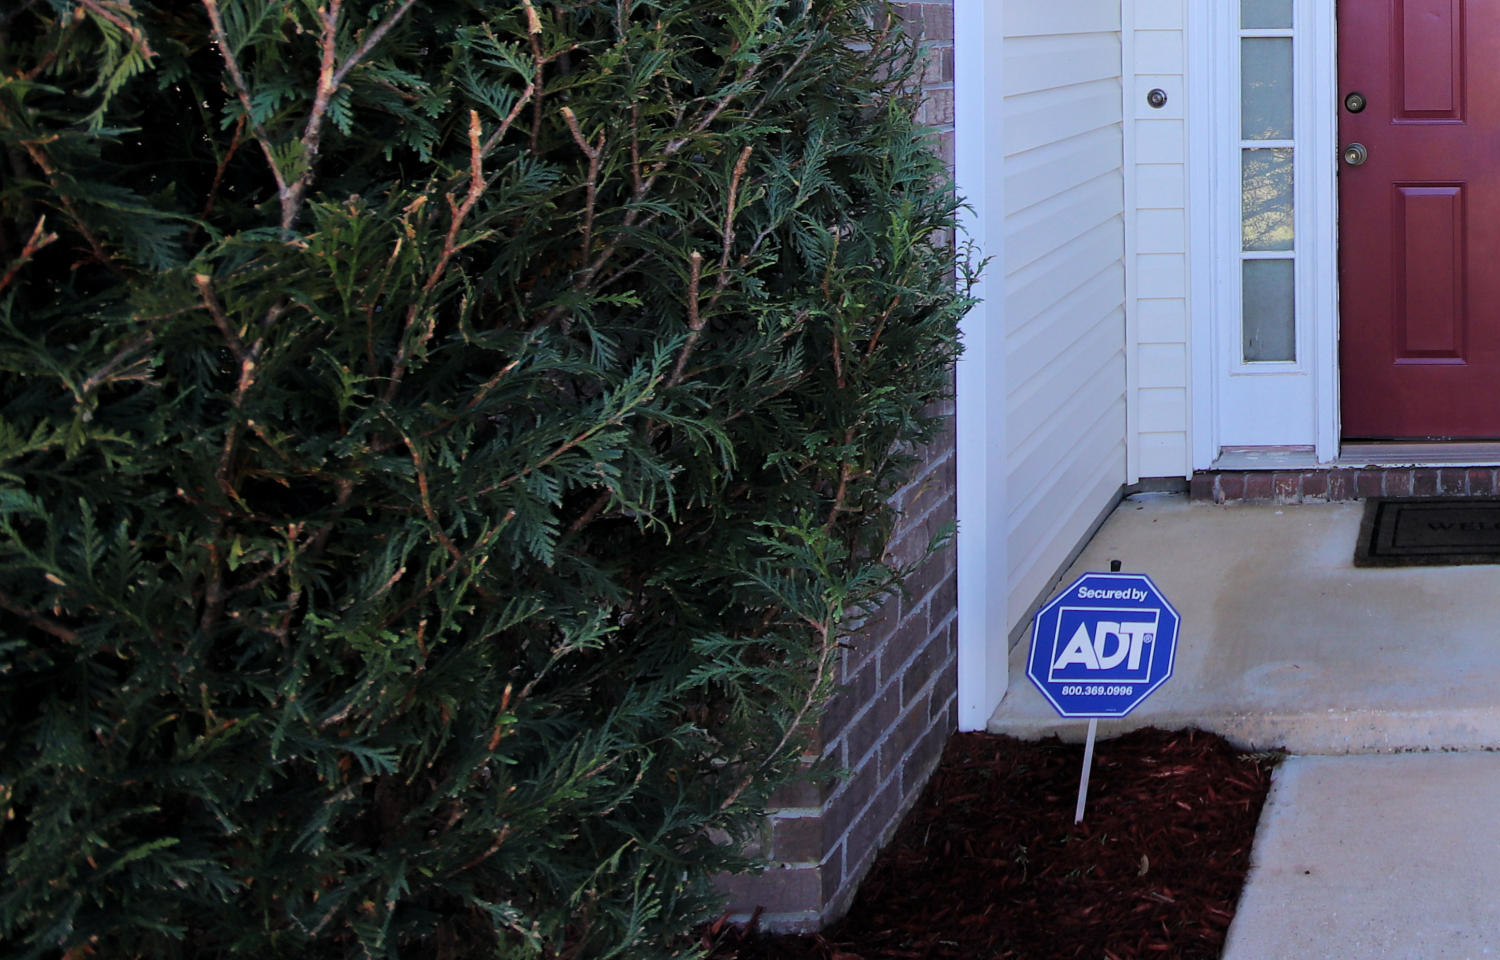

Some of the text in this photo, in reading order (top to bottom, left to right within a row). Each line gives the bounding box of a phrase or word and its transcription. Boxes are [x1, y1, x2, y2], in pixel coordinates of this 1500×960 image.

[1077, 586, 1148, 602] Secured by
[1053, 621, 1156, 670] ADT
